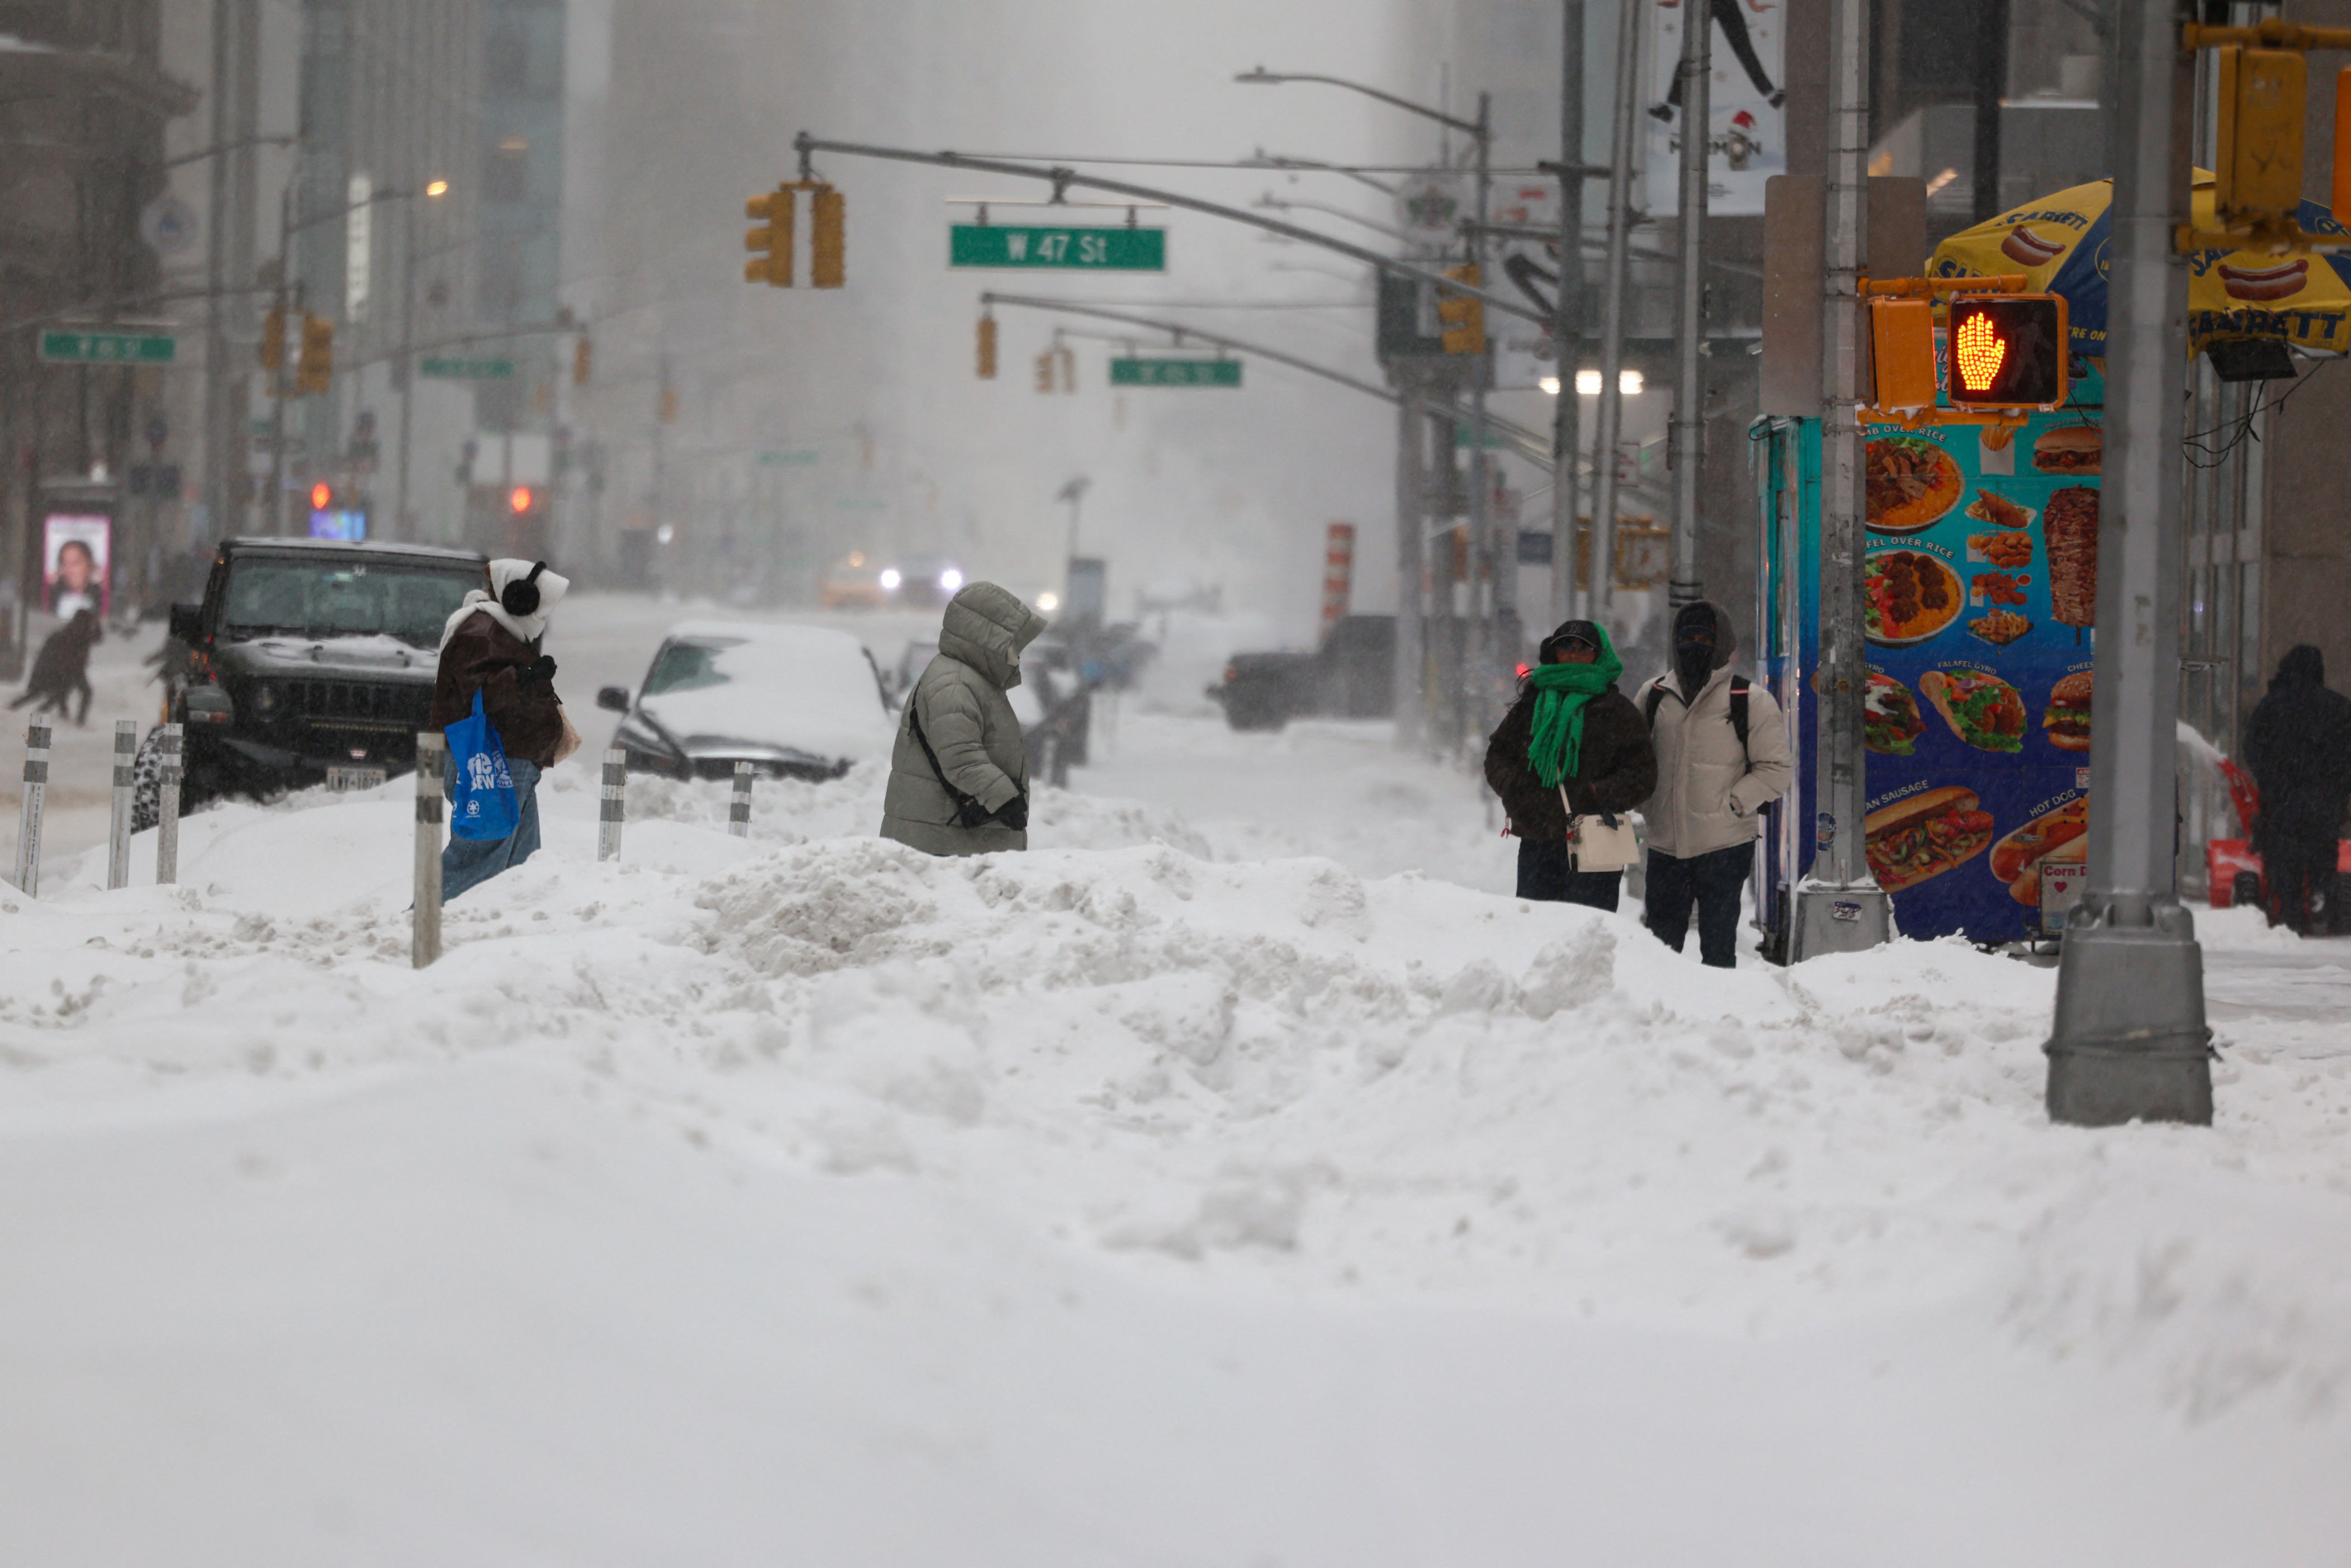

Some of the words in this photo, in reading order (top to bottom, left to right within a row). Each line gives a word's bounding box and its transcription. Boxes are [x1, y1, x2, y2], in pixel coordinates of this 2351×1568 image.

[1007, 234, 1028, 262] W
[1037, 235, 1070, 263] 47
[1080, 235, 1107, 263] St
[1918, 428, 1947, 443] RICE
[1890, 536, 1922, 548] OVER
[1926, 542, 1955, 560] RICE
[1938, 660, 1972, 669] FALAFEL
[1974, 663, 1997, 675] GYRO
[1881, 779, 1929, 804] SAUSAGE
[2029, 800, 2051, 817] HOT
[2051, 789, 2076, 806] DOG
[2043, 865, 2076, 877] Corn
